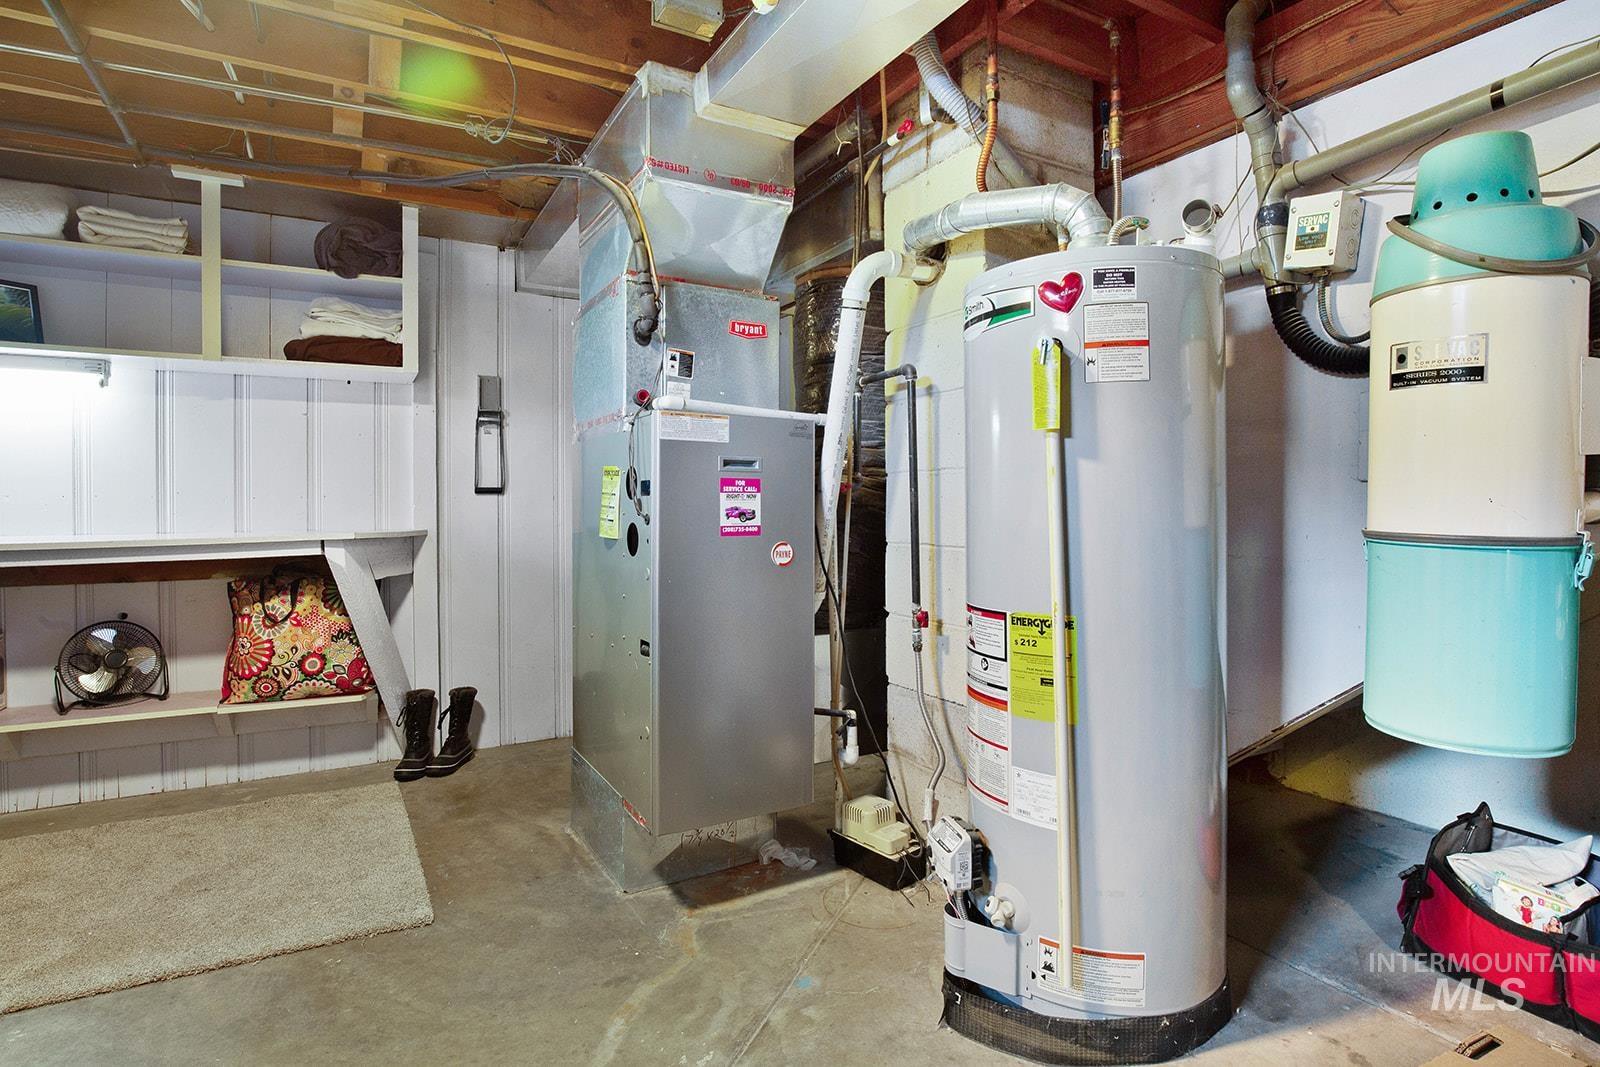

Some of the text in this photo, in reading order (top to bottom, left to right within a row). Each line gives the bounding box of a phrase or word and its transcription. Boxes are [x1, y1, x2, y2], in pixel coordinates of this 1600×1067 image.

[1299, 214, 1329, 226] SERVAC
[735, 322, 762, 335] bryant
[1414, 356, 1480, 367] CORPORATION
[775, 550, 791, 558] PAYNE
[1020, 638, 1038, 647] 212
